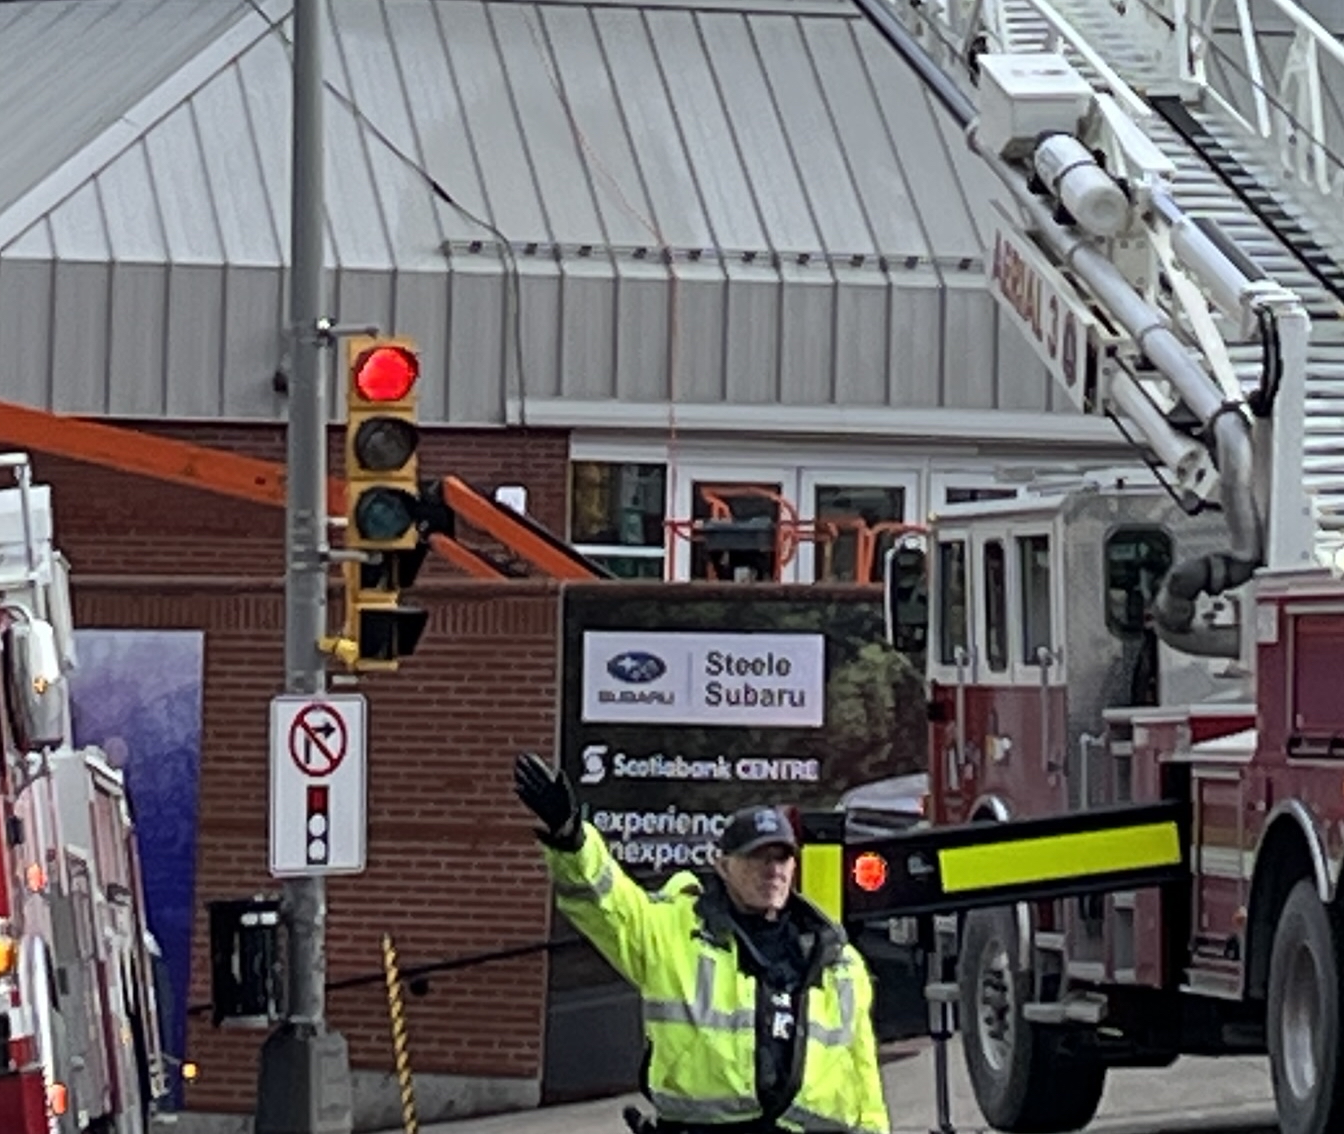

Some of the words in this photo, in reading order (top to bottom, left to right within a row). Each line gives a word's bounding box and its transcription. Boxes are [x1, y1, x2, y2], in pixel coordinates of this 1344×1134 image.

[705, 650, 792, 677] Steele
[705, 682, 806, 708] Subaru
[613, 752, 732, 779] Scotiabank
[735, 758, 819, 781] CENTRE
[593, 804, 735, 842] experienc
[609, 841, 723, 873] nexpect
